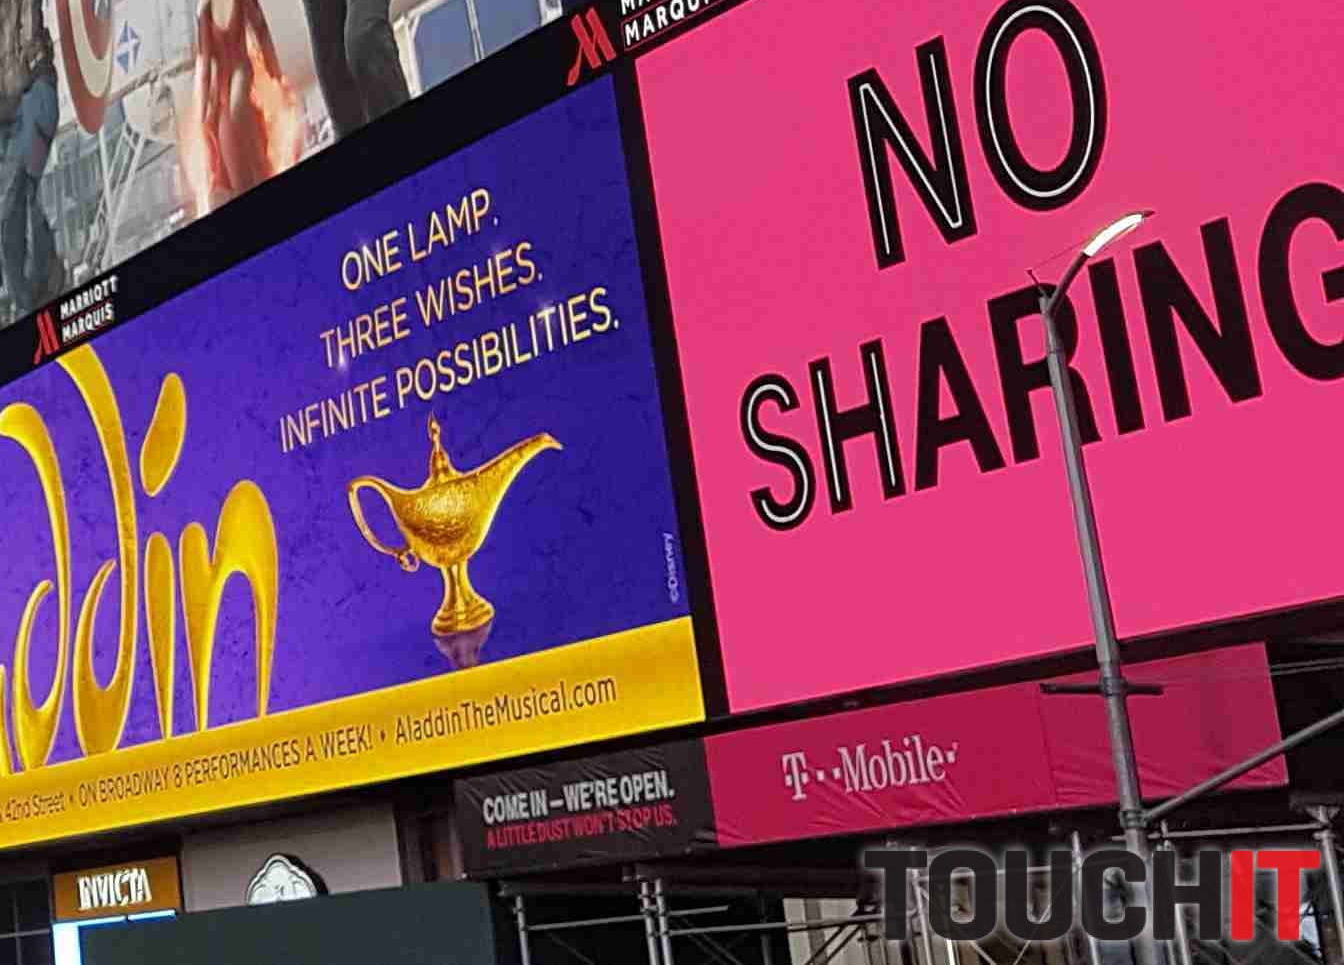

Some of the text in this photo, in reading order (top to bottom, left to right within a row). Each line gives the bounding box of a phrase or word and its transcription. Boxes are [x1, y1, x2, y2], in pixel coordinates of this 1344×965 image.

[341, 187, 499, 291] ONE LAMP.
[59, 275, 119, 321] MARRIOTT
[61, 303, 115, 343] MARQUIS
[319, 241, 545, 370] THREE WISHES.
[279, 286, 620, 454] INFINITE POSSIBILITIES.
[739, 182, 1344, 533] SHARING
[4, 797, 32, 822] 42nd
[32, 791, 66, 817] Street
[78, 780, 98, 808] ON
[97, 766, 170, 803] BROADWAY
[172, 763, 183, 789] 8
[184, 738, 302, 788] PERFORMANCES
[304, 739, 318, 763] A
[319, 722, 375, 759] WEEK!
[395, 674, 617, 746] AladdinTheMusical.com
[482, 792, 530, 825] COME
[530, 789, 549, 817] IN
[562, 777, 620, 812] WE'RE
[619, 770, 676, 805] OPEN.
[497, 823, 539, 848] LITTLE
[539, 817, 572, 843] DUST
[572, 811, 615, 838] WON'T
[617, 807, 655, 833] STOP
[655, 804, 678, 827] US.
[76, 867, 153, 911] INVICTA
